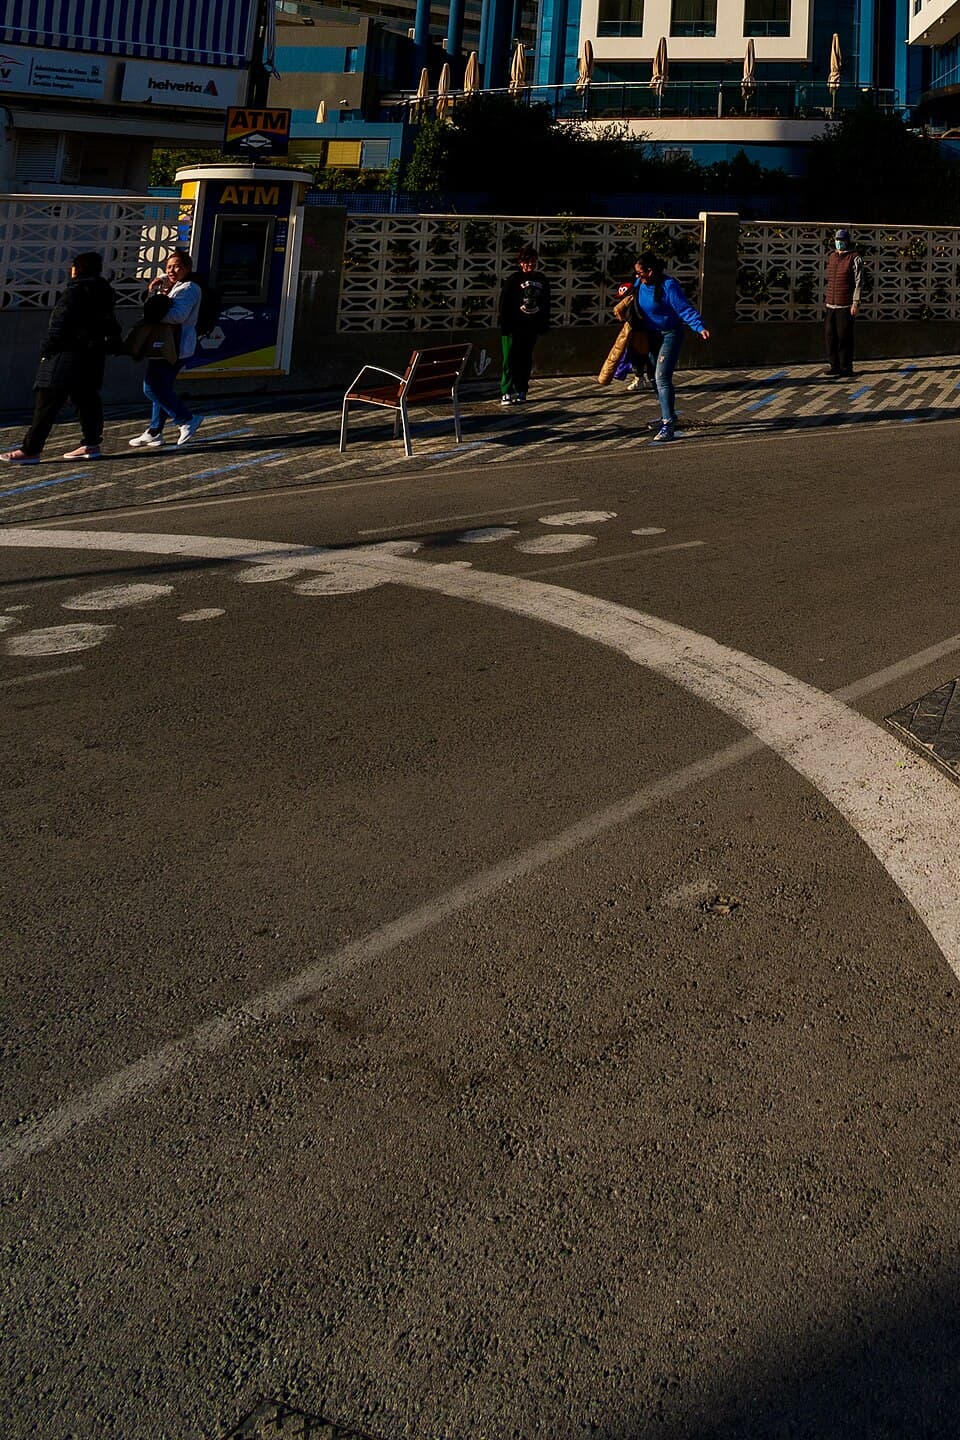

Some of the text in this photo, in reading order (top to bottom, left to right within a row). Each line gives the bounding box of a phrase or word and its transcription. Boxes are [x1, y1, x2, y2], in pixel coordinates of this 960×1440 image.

[148, 78, 202, 93] helvetia
[230, 111, 286, 130] ATM
[219, 186, 279, 205] ATM
